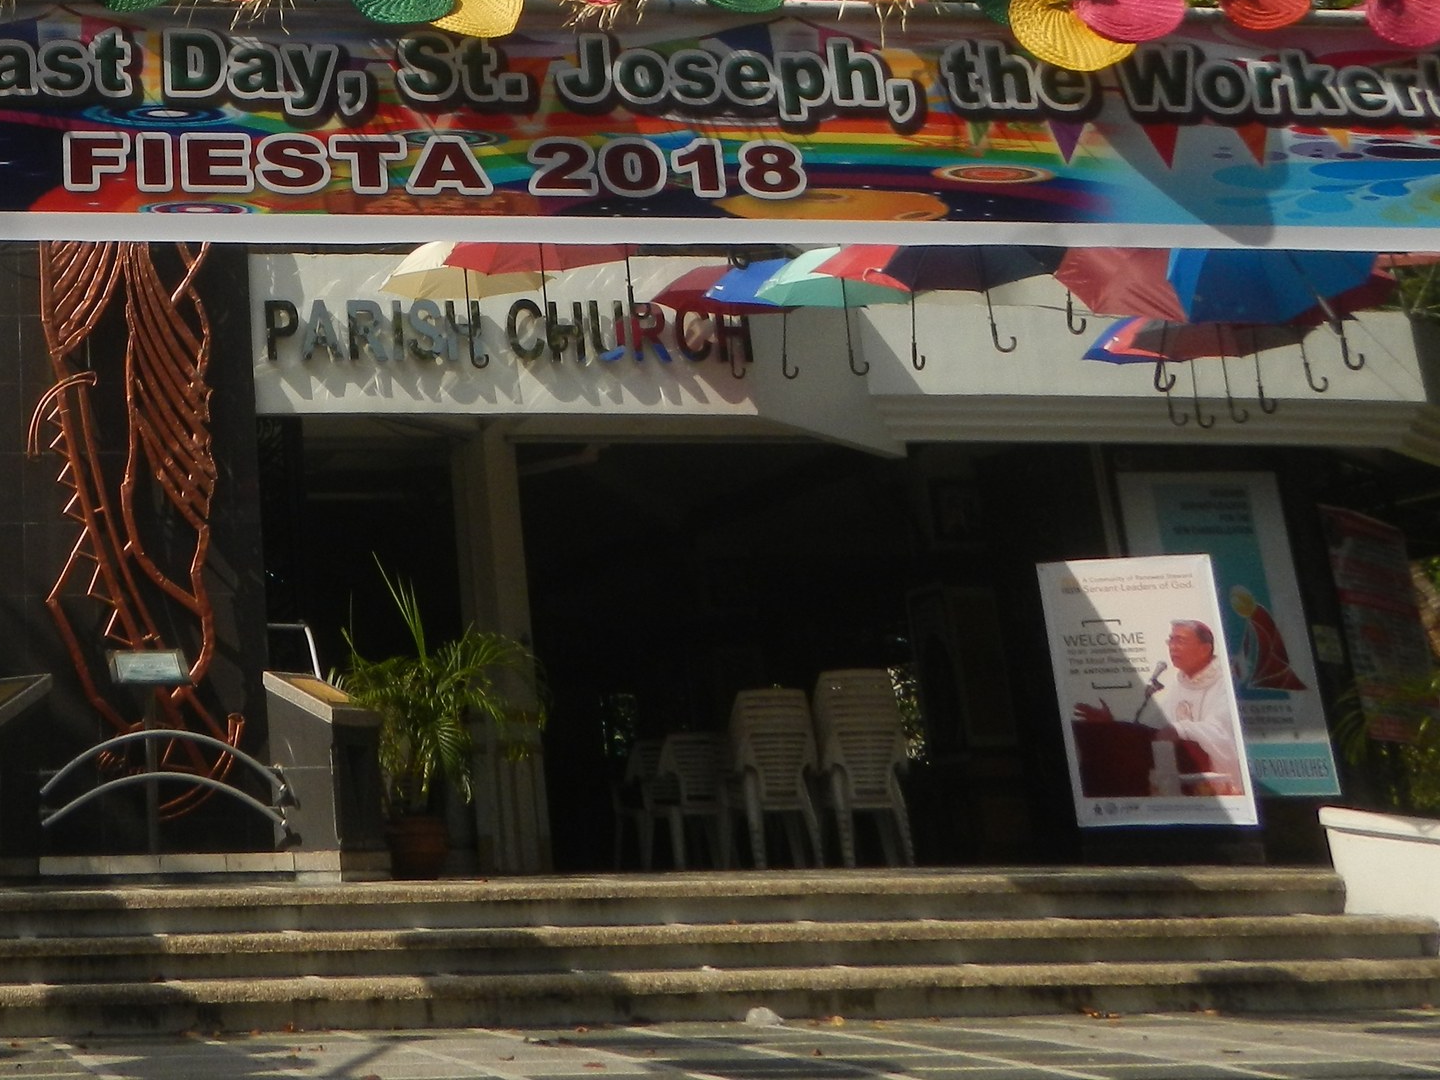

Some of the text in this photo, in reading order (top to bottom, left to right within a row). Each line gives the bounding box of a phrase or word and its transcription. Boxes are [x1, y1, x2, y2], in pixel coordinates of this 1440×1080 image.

[164, 27, 372, 116] Day,
[396, 29, 533, 103] St.
[560, 32, 919, 124] Joseph,
[940, 39, 1092, 111] the
[62, 130, 808, 200] FIESTA 2018
[264, 299, 481, 362] PARISH
[506, 299, 755, 363] CHURCH
[1063, 632, 1145, 647] WELCOME
